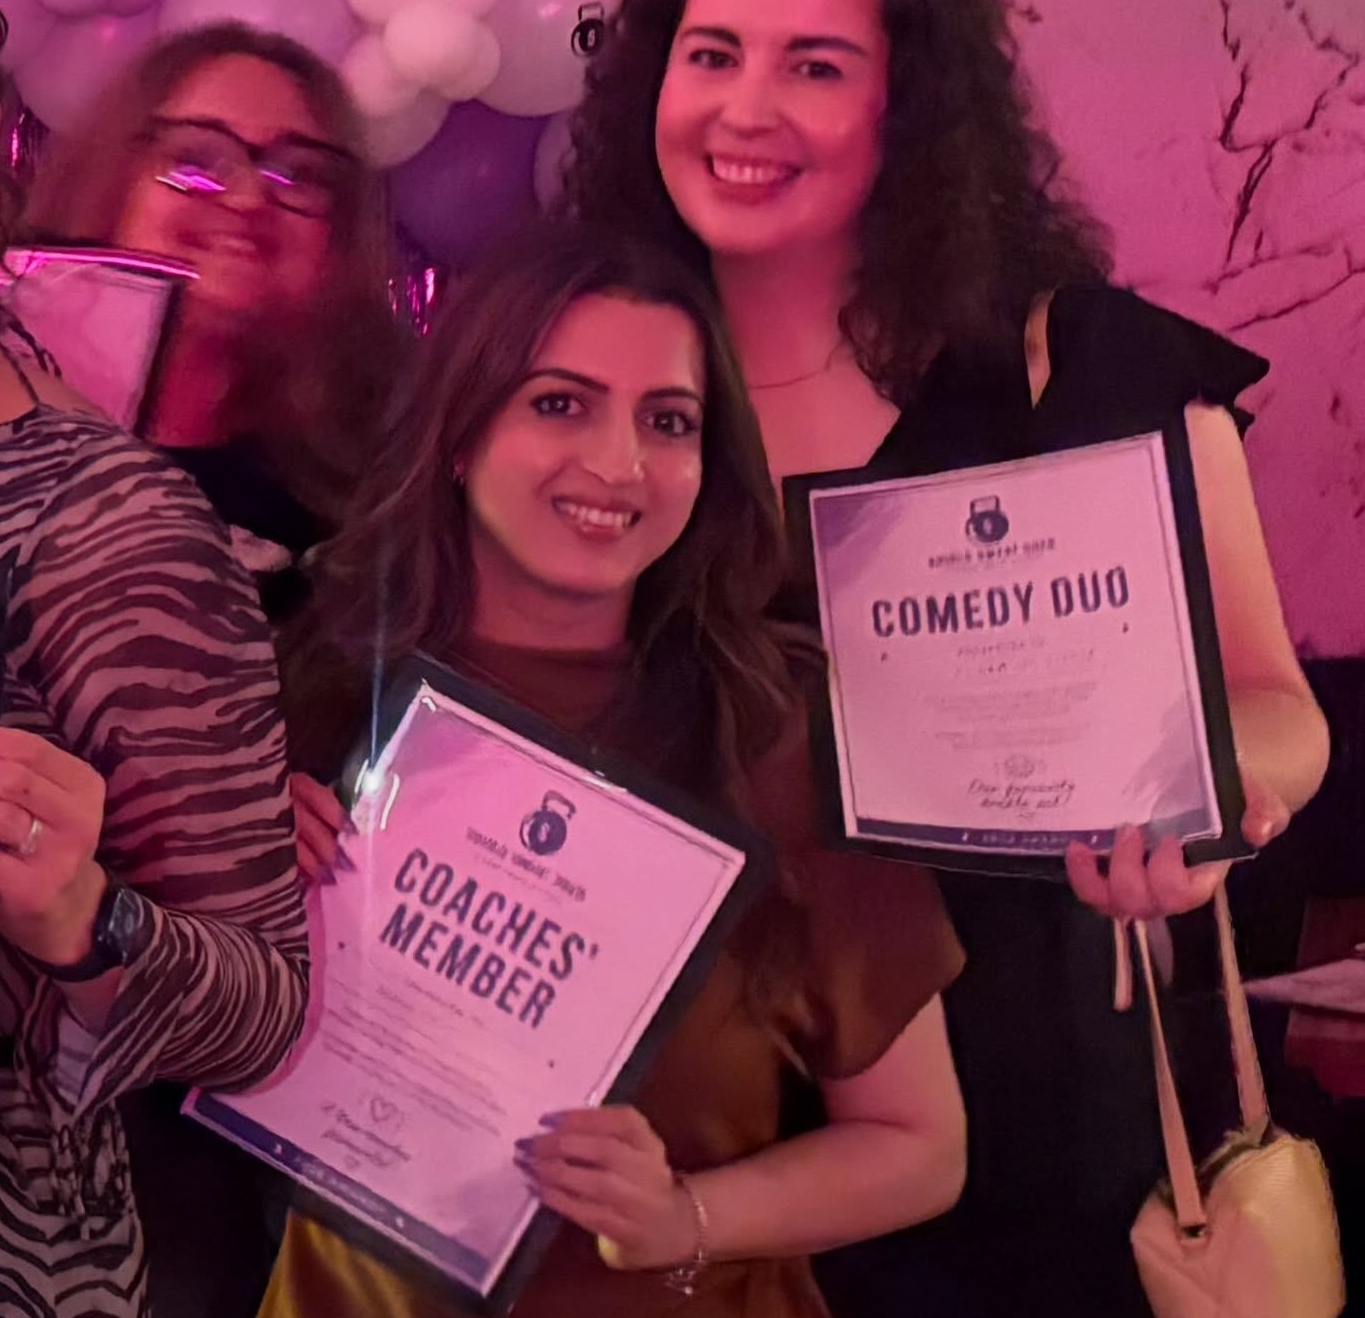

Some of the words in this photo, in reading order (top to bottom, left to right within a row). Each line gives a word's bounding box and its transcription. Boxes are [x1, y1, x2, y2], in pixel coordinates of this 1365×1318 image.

[872, 581, 1034, 638] COMEDY
[1050, 565, 1129, 618] DUO
[379, 902, 557, 1030] MEMBER
[394, 847, 599, 981] COACHES'
